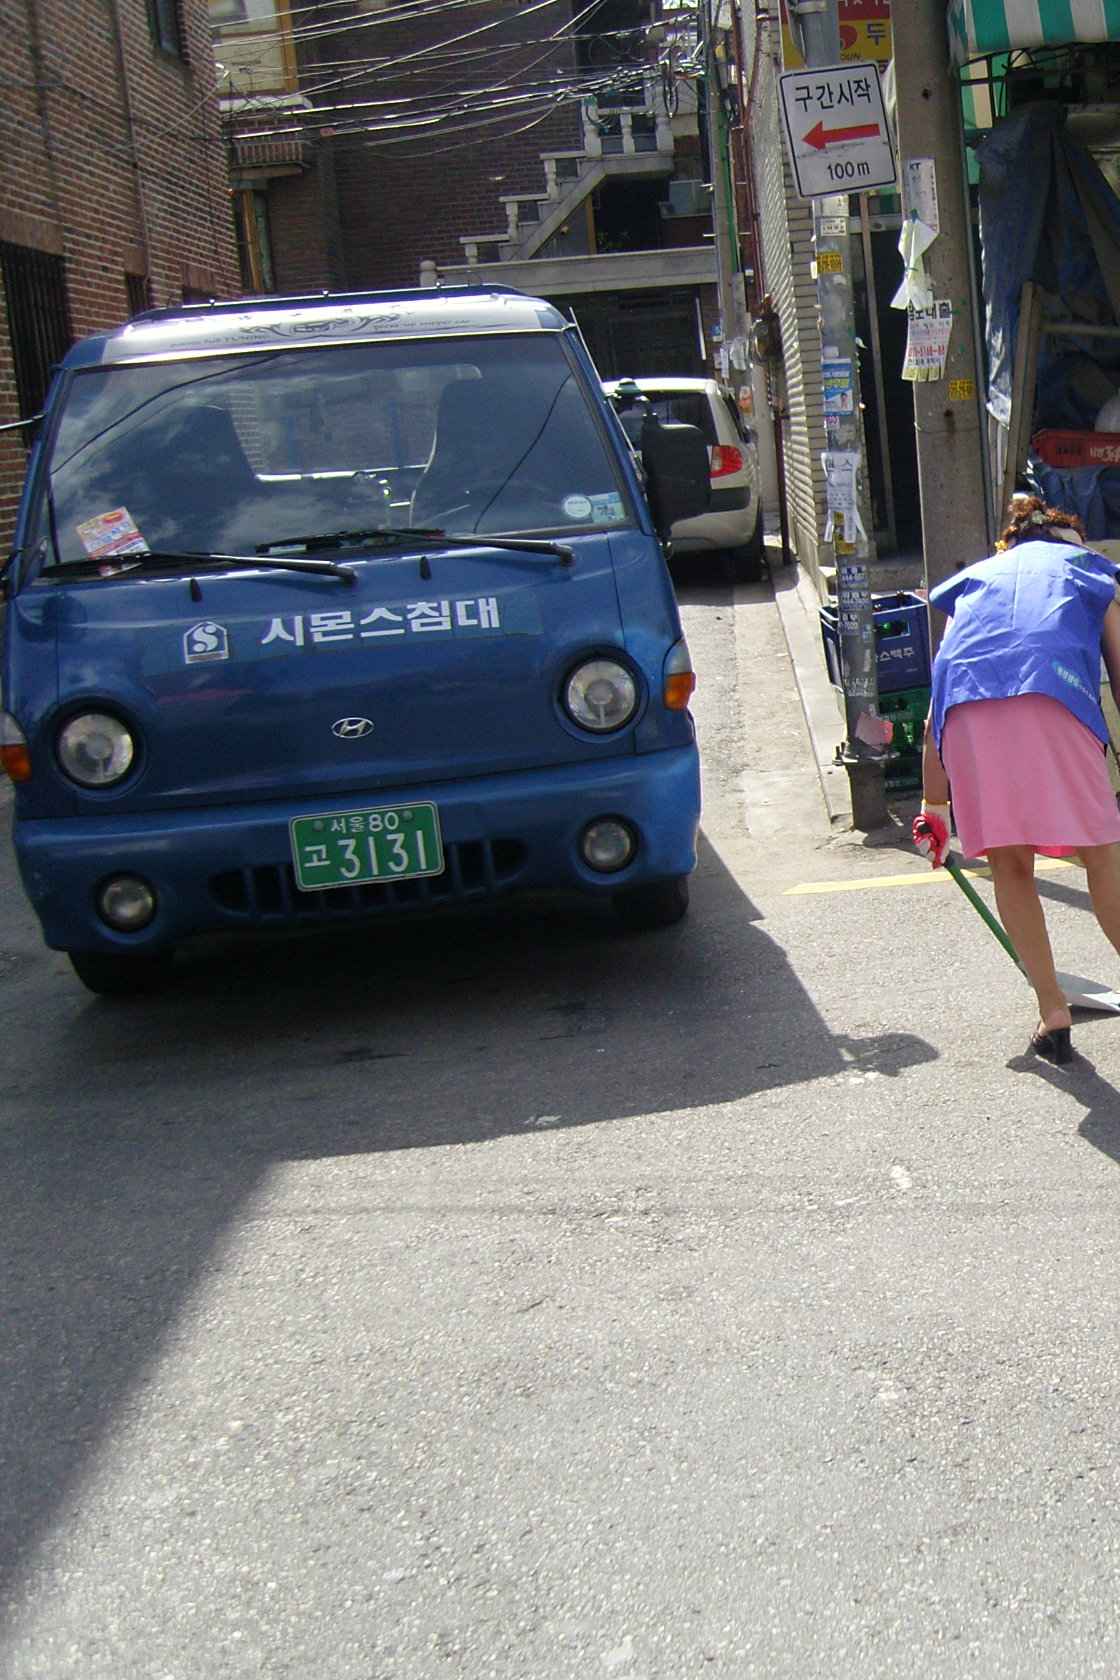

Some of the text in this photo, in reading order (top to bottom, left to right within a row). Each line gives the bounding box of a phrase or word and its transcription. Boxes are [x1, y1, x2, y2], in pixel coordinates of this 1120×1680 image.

[794, 77, 871, 112] 구간시작
[826, 161, 870, 181] 100m
[261, 597, 500, 646] 시몬스침대
